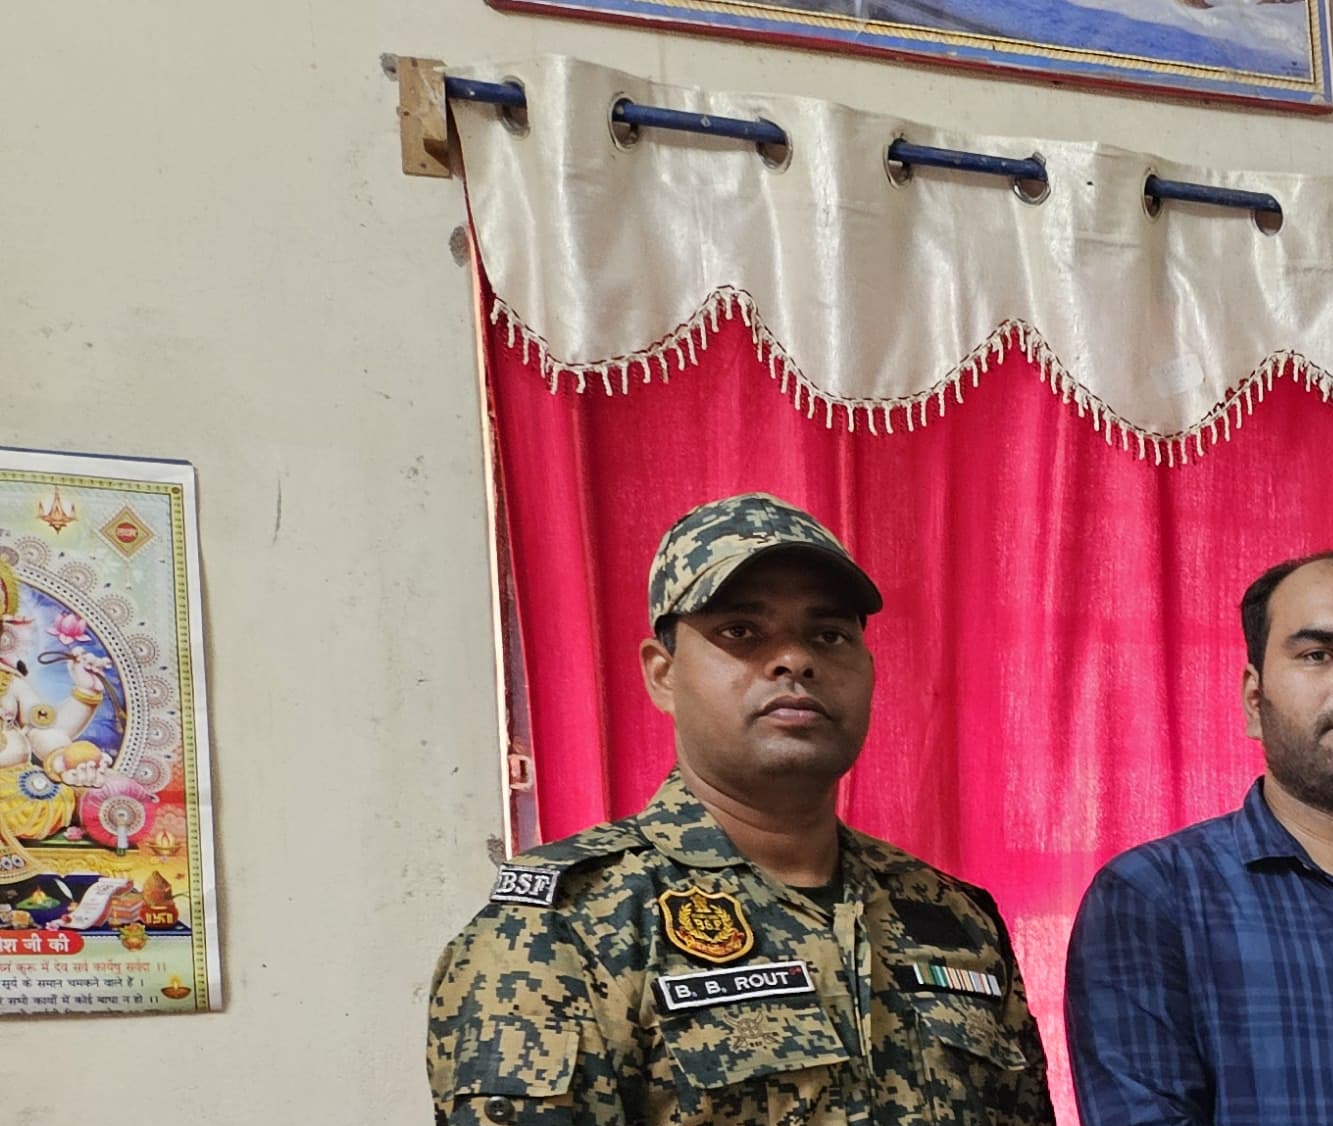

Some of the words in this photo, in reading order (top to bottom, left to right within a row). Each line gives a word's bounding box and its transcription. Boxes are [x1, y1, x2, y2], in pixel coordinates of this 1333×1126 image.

[495, 871, 551, 896] BSF
[22, 932, 42, 953] जी
[47, 932, 70, 953] की
[674, 985, 698, 999] B.
[704, 980, 728, 994] B.
[733, 971, 789, 991] ROUT
